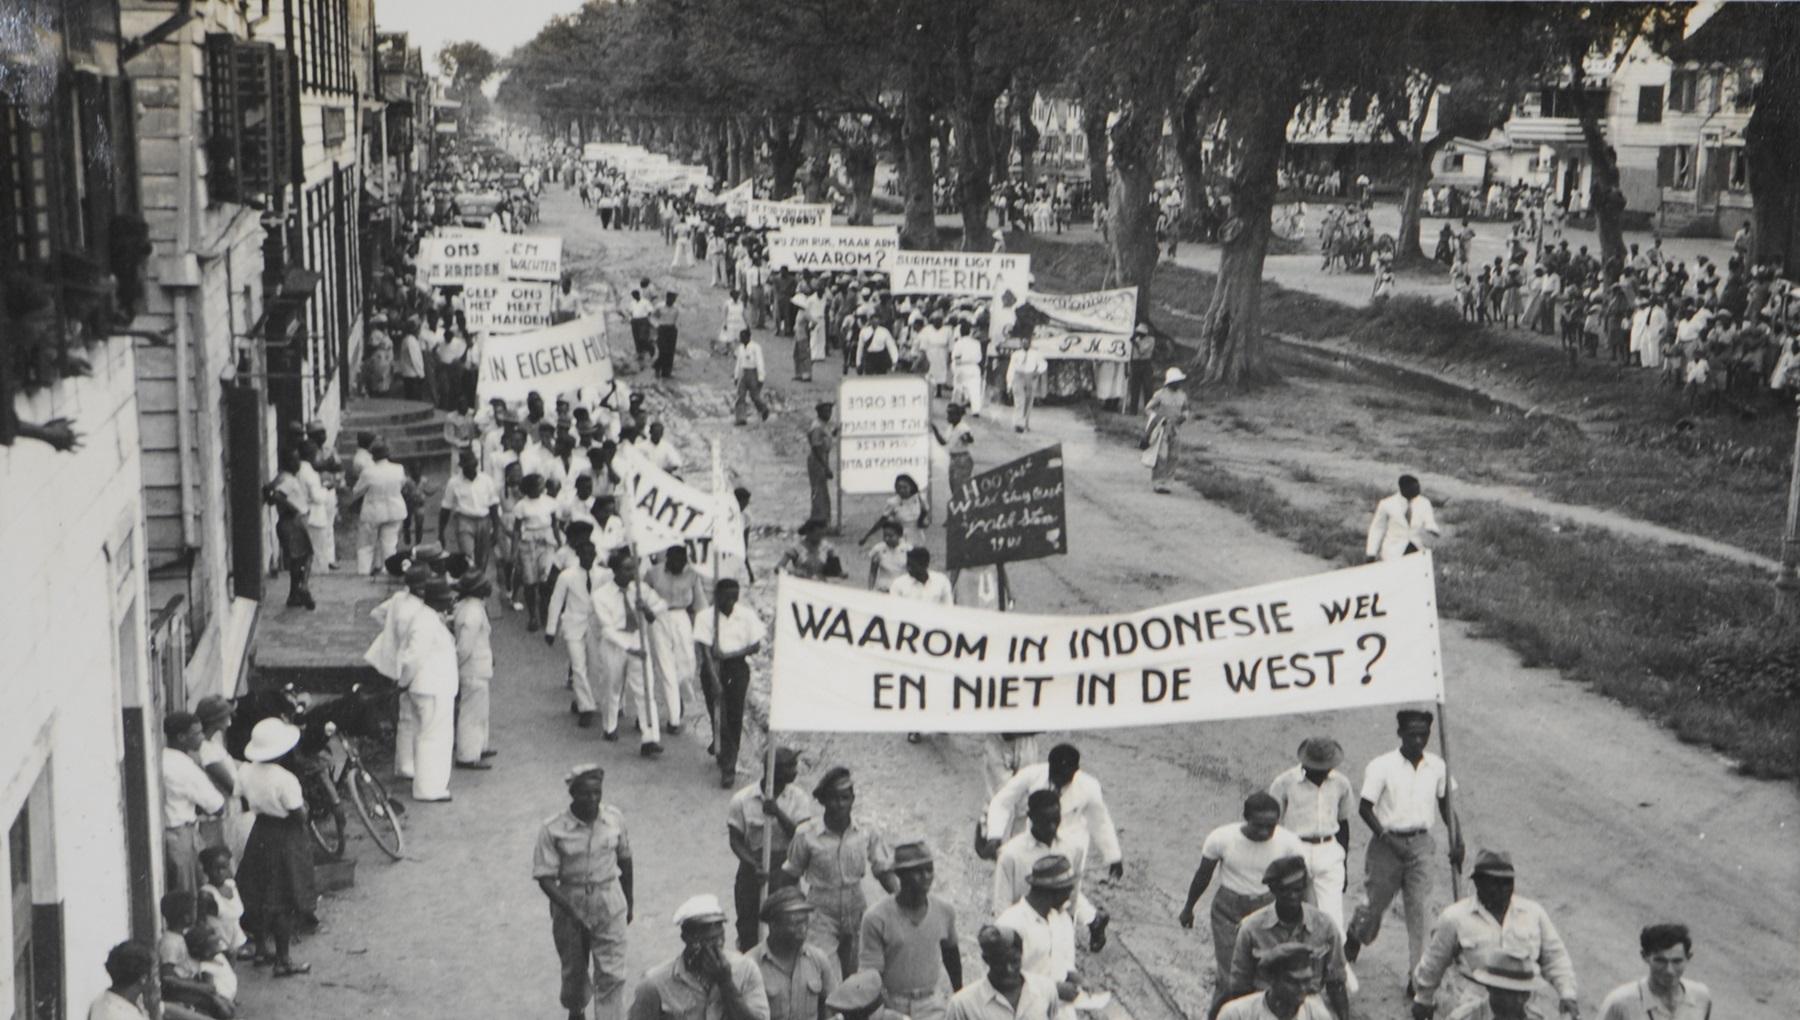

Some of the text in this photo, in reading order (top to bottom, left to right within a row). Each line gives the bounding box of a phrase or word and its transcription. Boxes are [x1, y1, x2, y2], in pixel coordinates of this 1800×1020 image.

[444, 242, 481, 258] ONS
[838, 237, 871, 247] MAAR
[874, 238, 896, 248] ARM
[444, 262, 500, 277] HANDEN
[896, 255, 1016, 270] SURINAME LIGT IN
[465, 287, 543, 300] GEEF ONS
[507, 302, 541, 313] HEFT
[491, 313, 550, 327] HANDEN
[488, 354, 509, 384] IN
[516, 341, 579, 381] EIGEN
[789, 591, 1387, 665] WAAROM IN INDONESIE WEL
[873, 673, 926, 711] EN
[952, 675, 1055, 710] NIET
[1076, 671, 1115, 707] IN
[1141, 668, 1192, 705] DE
